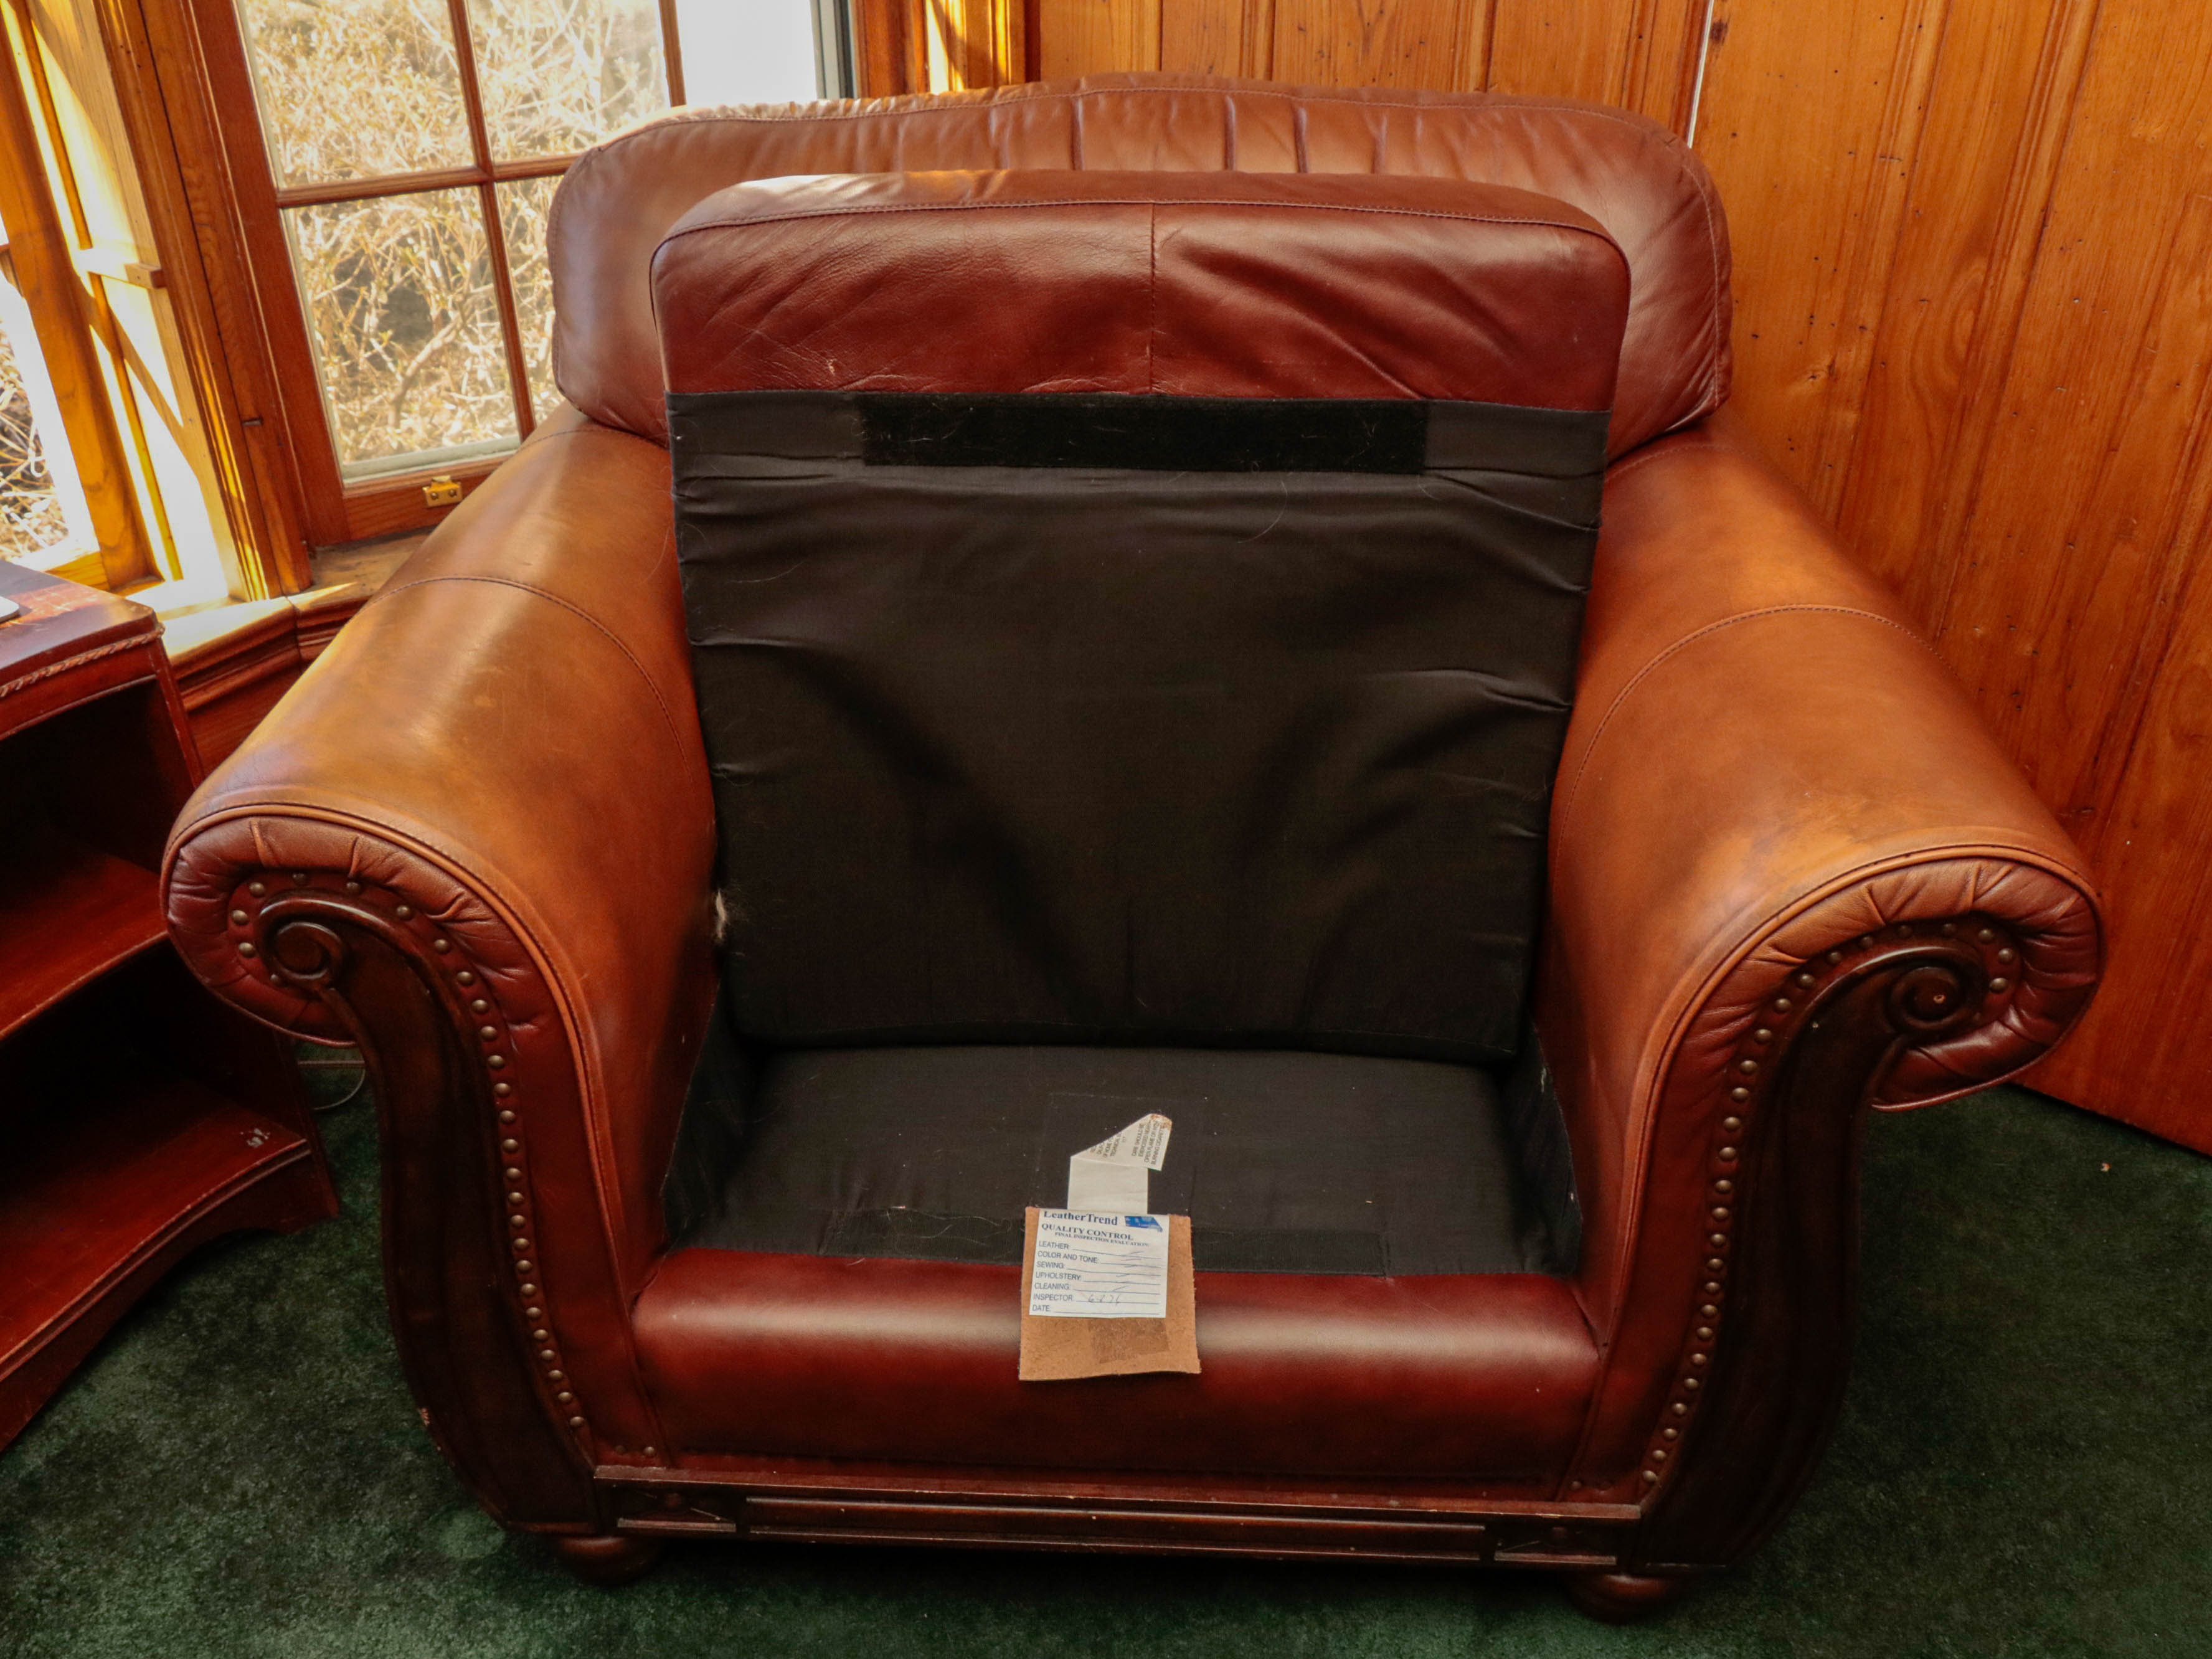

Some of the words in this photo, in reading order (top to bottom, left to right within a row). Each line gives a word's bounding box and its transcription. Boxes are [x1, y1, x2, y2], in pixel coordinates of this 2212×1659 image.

[1041, 1223, 1085, 1234] QUALITY
[1086, 1229, 1134, 1241] CONTROL
[1074, 1234, 1109, 1242] INSPECTION
[1037, 1250, 1061, 1259] COLOR
